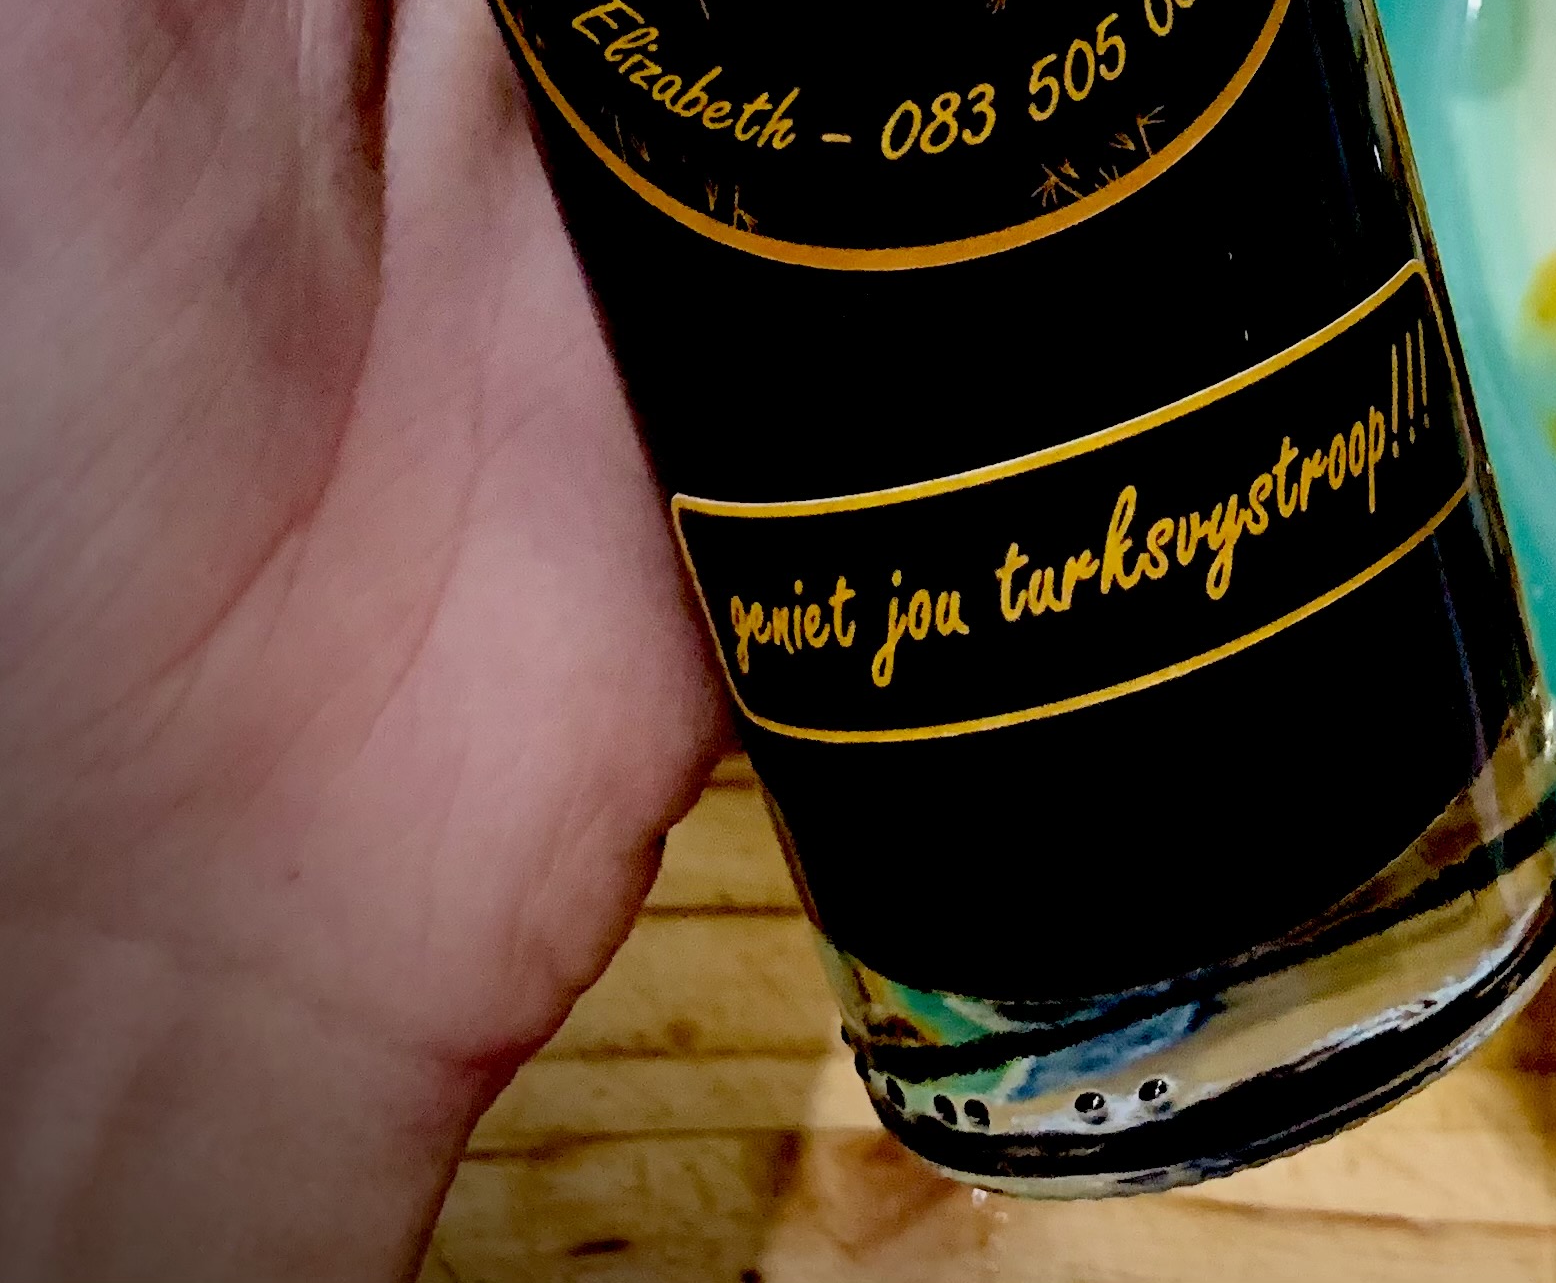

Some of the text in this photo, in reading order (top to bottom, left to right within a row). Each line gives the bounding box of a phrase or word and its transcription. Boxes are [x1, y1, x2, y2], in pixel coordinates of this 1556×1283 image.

[881, 83, 997, 160] 083
[1027, 13, 1127, 122] 505
[730, 319, 1431, 687] geniet jou turksvystroop!!!
